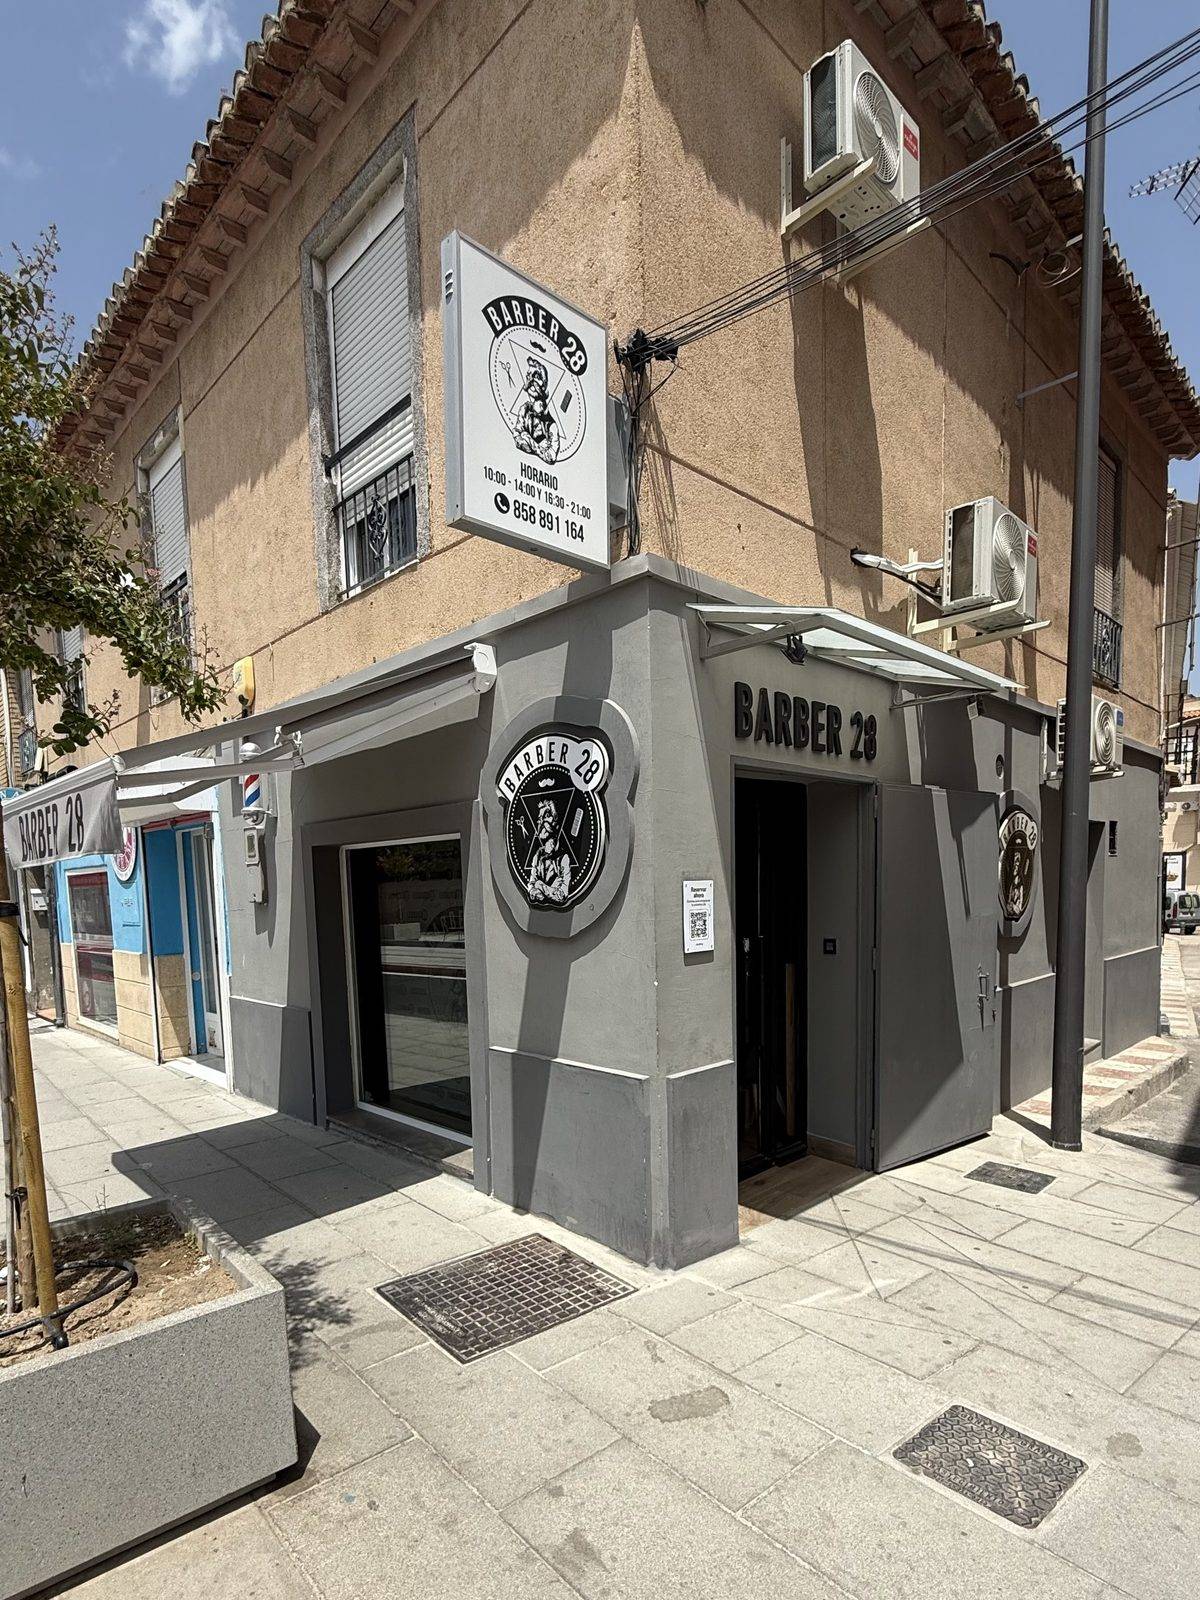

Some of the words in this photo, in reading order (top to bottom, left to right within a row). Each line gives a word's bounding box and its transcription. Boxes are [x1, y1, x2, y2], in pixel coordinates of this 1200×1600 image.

[486, 299, 560, 342] BARBER
[561, 336, 586, 372] 28
[484, 465, 506, 486] 10:00
[514, 478, 536, 498] 14:00
[537, 488, 542, 500] Y
[545, 491, 565, 509] 16:30
[571, 502, 591, 520] 21:00
[520, 461, 558, 491] HORARIO
[513, 499, 536, 525] 858
[539, 509, 560, 534] 891
[565, 519, 585, 542] 164
[734, 681, 843, 756] BARBER
[850, 710, 878, 761] 28
[504, 741, 569, 794] BARBER
[574, 748, 600, 785] 28
[18, 803, 59, 862] BARBER
[65, 792, 85, 852] 28
